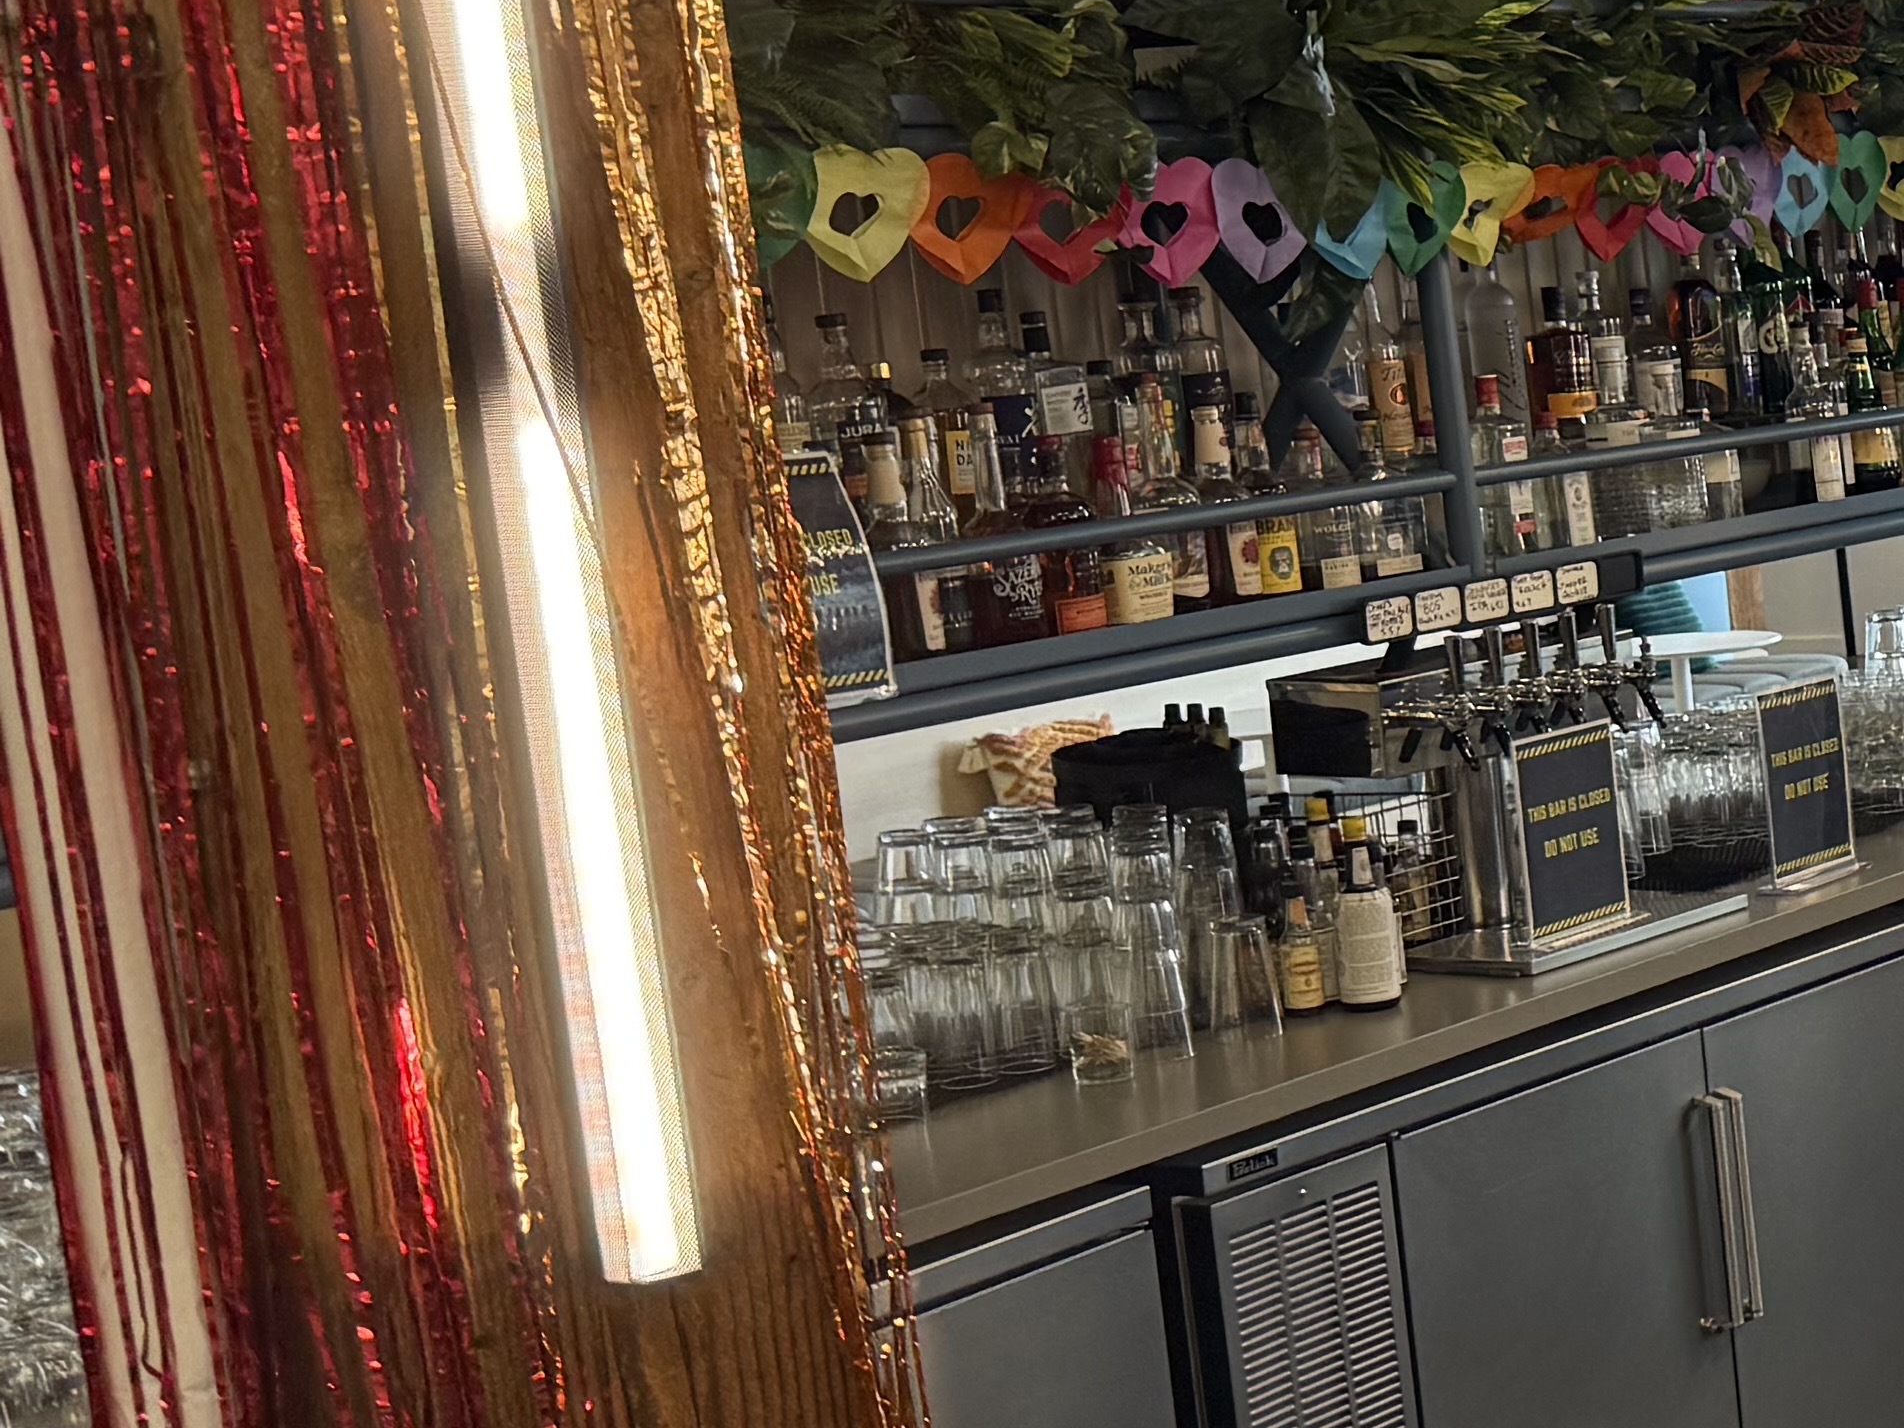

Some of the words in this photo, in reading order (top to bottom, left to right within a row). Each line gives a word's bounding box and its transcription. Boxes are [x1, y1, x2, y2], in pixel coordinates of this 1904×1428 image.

[840, 422, 884, 439] JURA
[808, 573, 841, 596] USE
[1771, 751, 1788, 768] THIS
[1787, 746, 1803, 764] BAR
[1803, 744, 1812, 759] IS
[1812, 737, 1840, 758] CLOSED
[1784, 782, 1796, 800] DO
[1796, 778, 1812, 797] NOT
[1813, 772, 1830, 792] USE
[1527, 804, 1547, 823] THIS
[1548, 799, 1567, 818] BAR
[1567, 796, 1577, 812] IS
[1578, 787, 1611, 810] CLOSED
[1544, 839, 1558, 858] DO
[1559, 833, 1578, 853] NOT
[1579, 827, 1600, 848] USE
